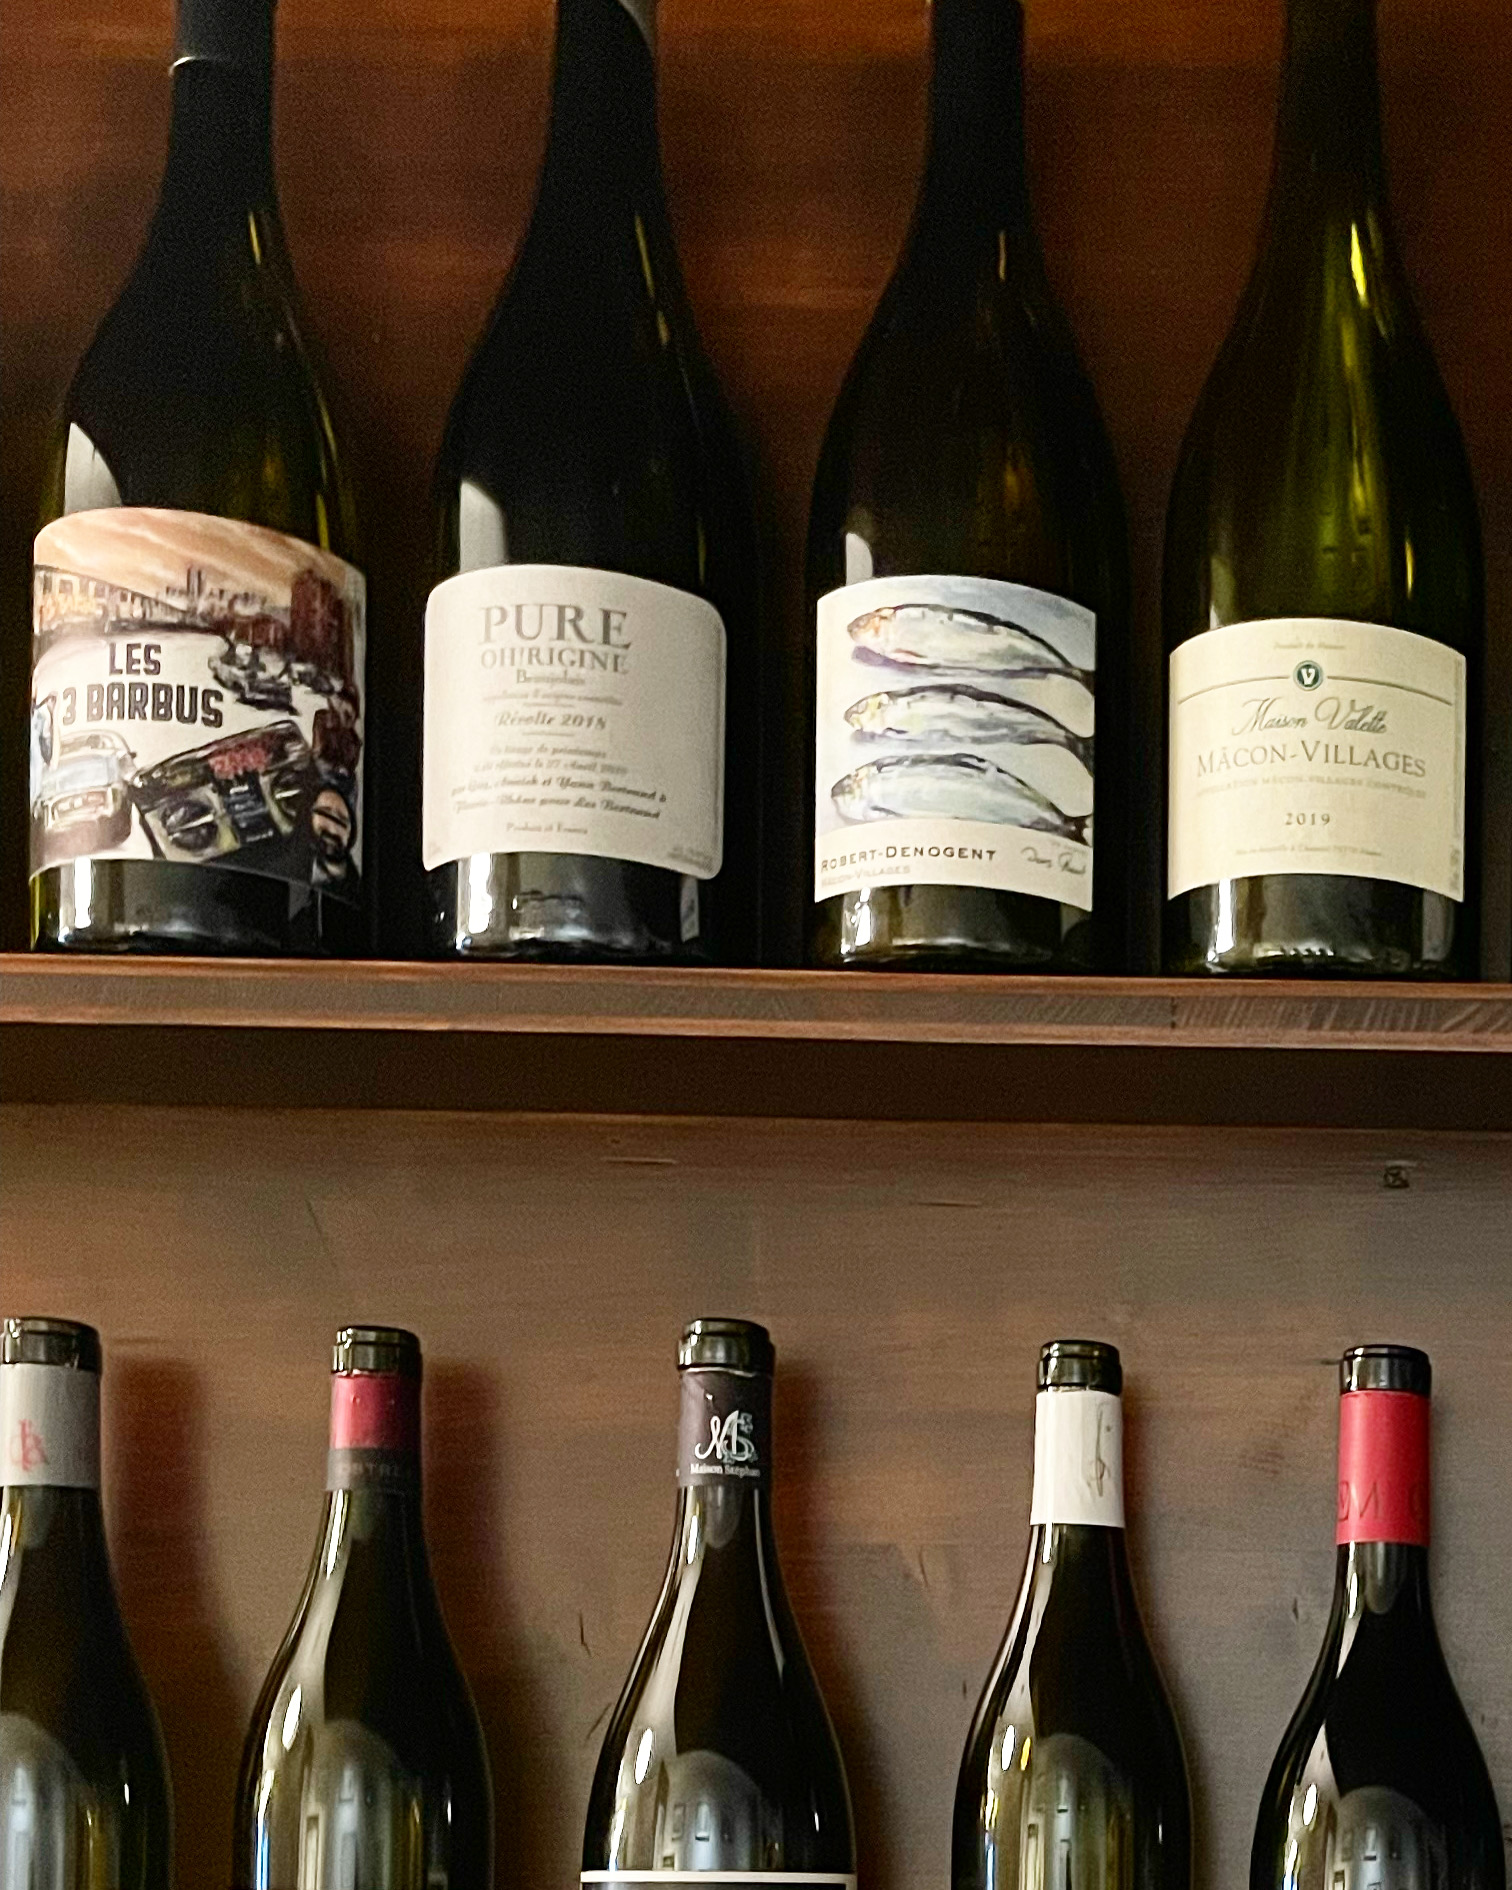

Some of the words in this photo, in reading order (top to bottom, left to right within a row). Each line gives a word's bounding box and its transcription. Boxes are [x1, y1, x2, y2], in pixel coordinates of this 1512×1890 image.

[480, 603, 632, 650] PURE
[108, 643, 162, 676] LES
[62, 686, 77, 726] 3
[86, 682, 224, 728] BARBUS
[1231, 697, 1308, 737] Maison
[1196, 739, 1427, 779] MÂCON-VILLAGES
[1284, 812, 1331, 826] 2019
[820, 846, 997, 874] ROBERT-DENOGENT
